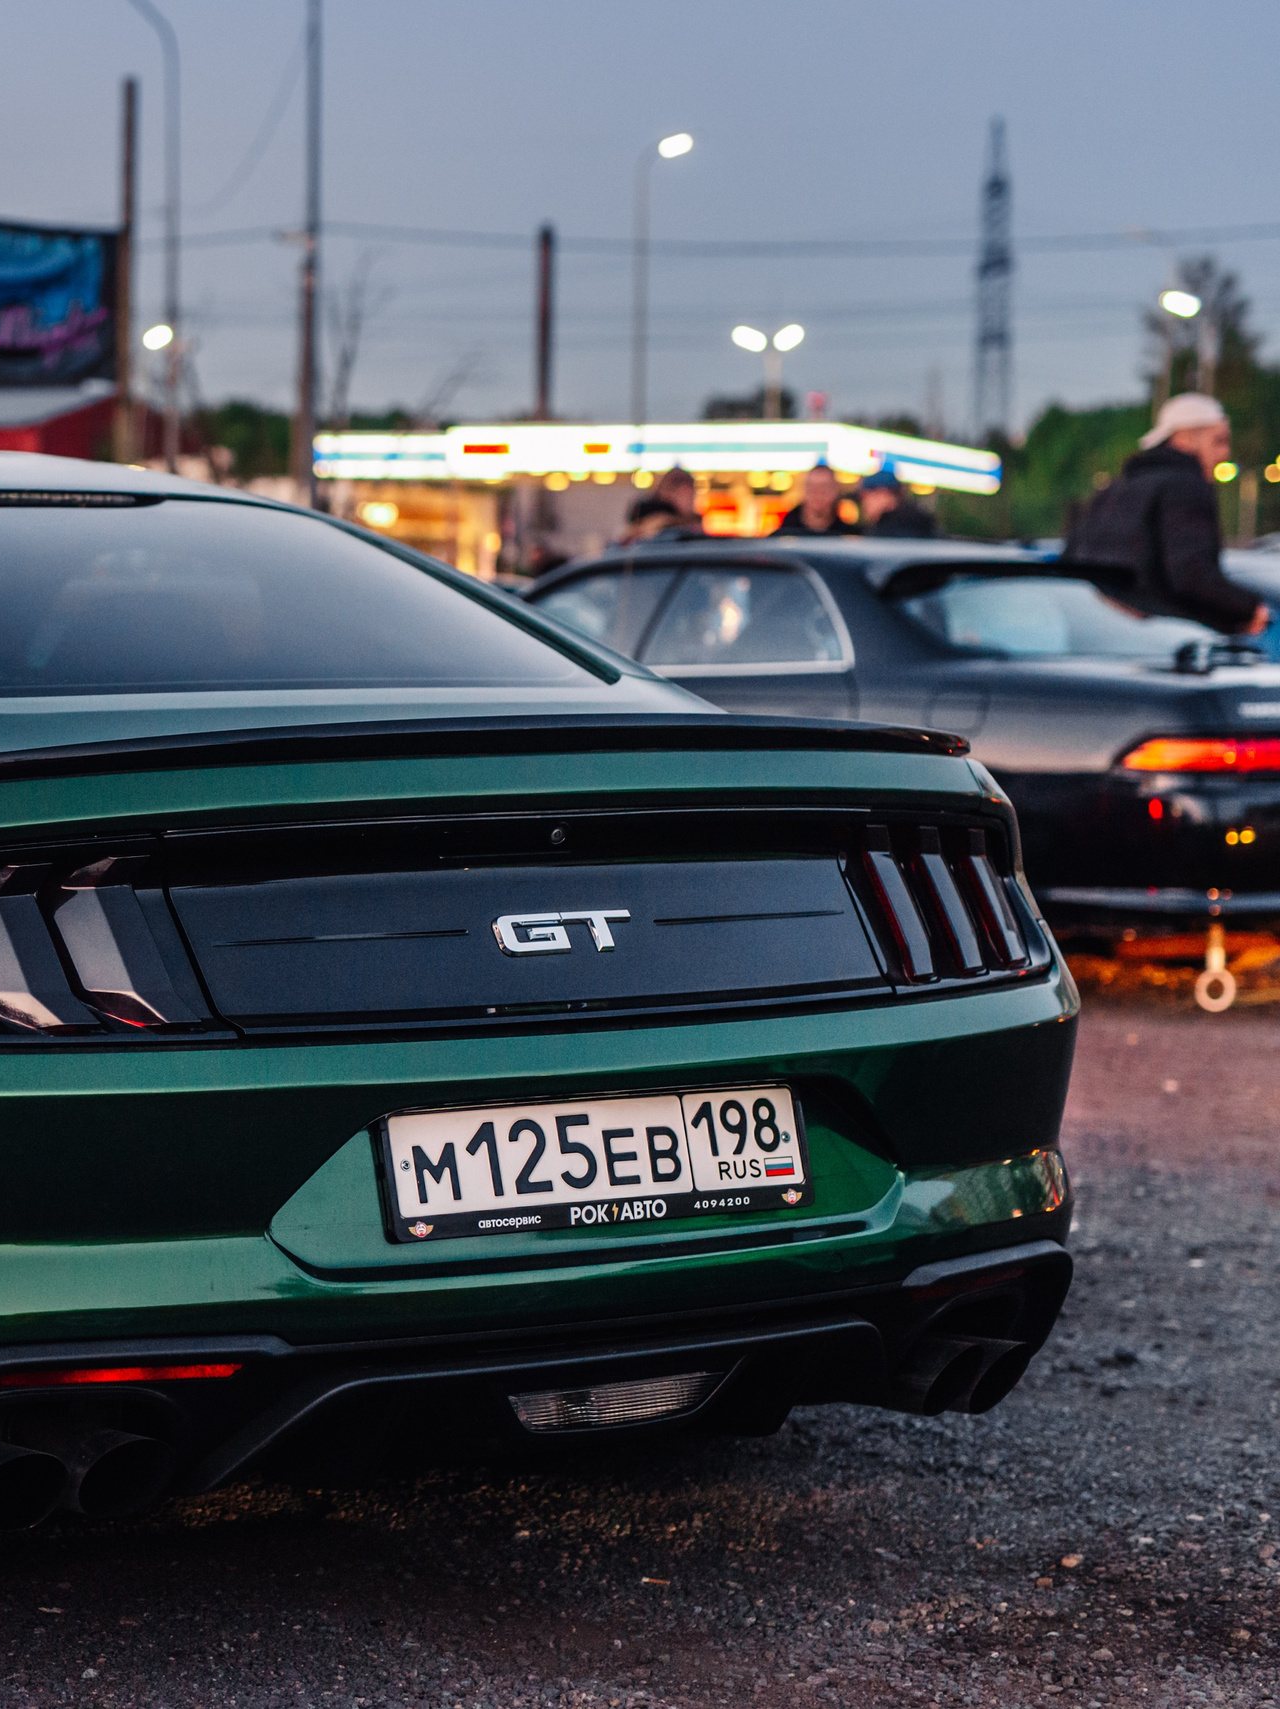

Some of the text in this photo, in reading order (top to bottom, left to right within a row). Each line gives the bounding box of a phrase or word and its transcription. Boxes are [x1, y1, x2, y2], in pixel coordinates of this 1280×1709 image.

[492, 909, 631, 957] GT
[691, 1097, 780, 1157] 198
[718, 1158, 762, 1181] RUS
[478, 1214, 542, 1229] автосервис
[694, 1196, 751, 1209] 4094200
